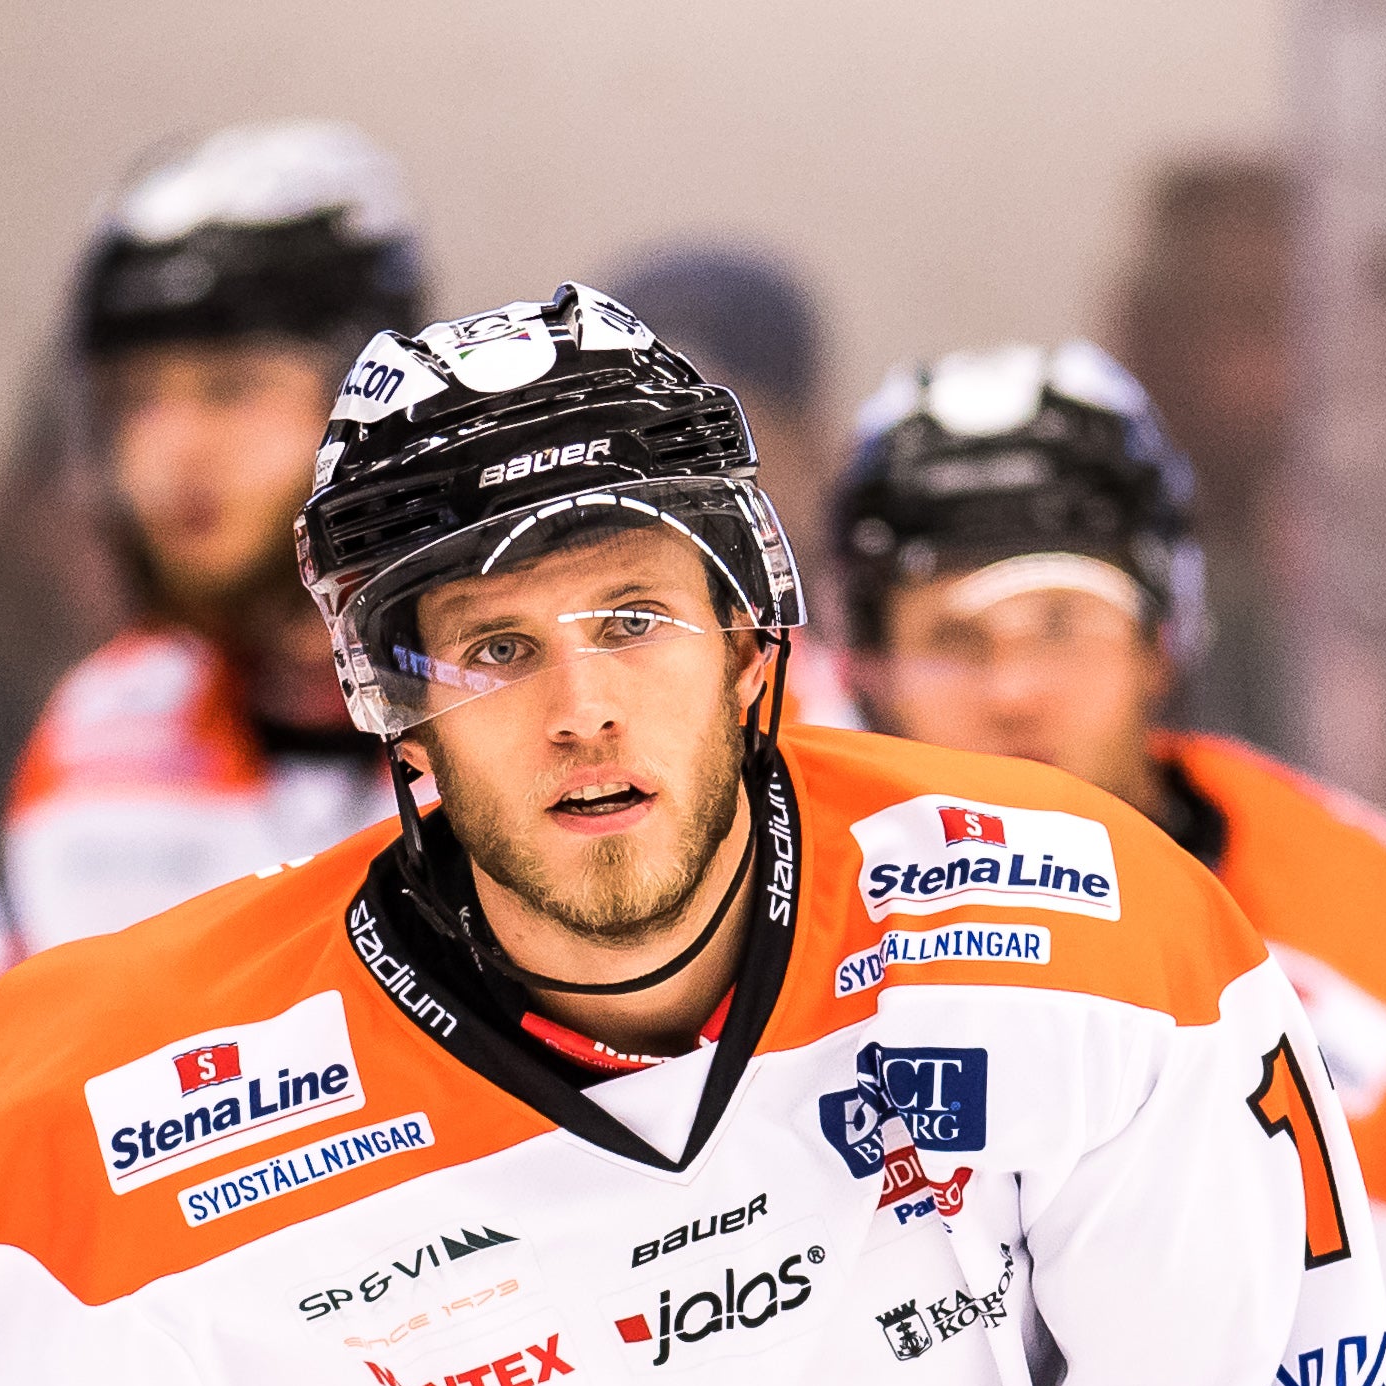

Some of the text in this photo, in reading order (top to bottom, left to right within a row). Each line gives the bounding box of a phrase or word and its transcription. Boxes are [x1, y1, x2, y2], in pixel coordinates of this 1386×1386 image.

[868, 853, 1111, 899] Stena Line
[349, 899, 458, 1038] stadium
[838, 930, 1041, 993] SYDÄLLNINGAR
[111, 1062, 350, 1170] Stena Line
[1246, 1032, 1351, 1271] 1
[186, 1119, 427, 1222] SYDSTÄLLNINGAR
